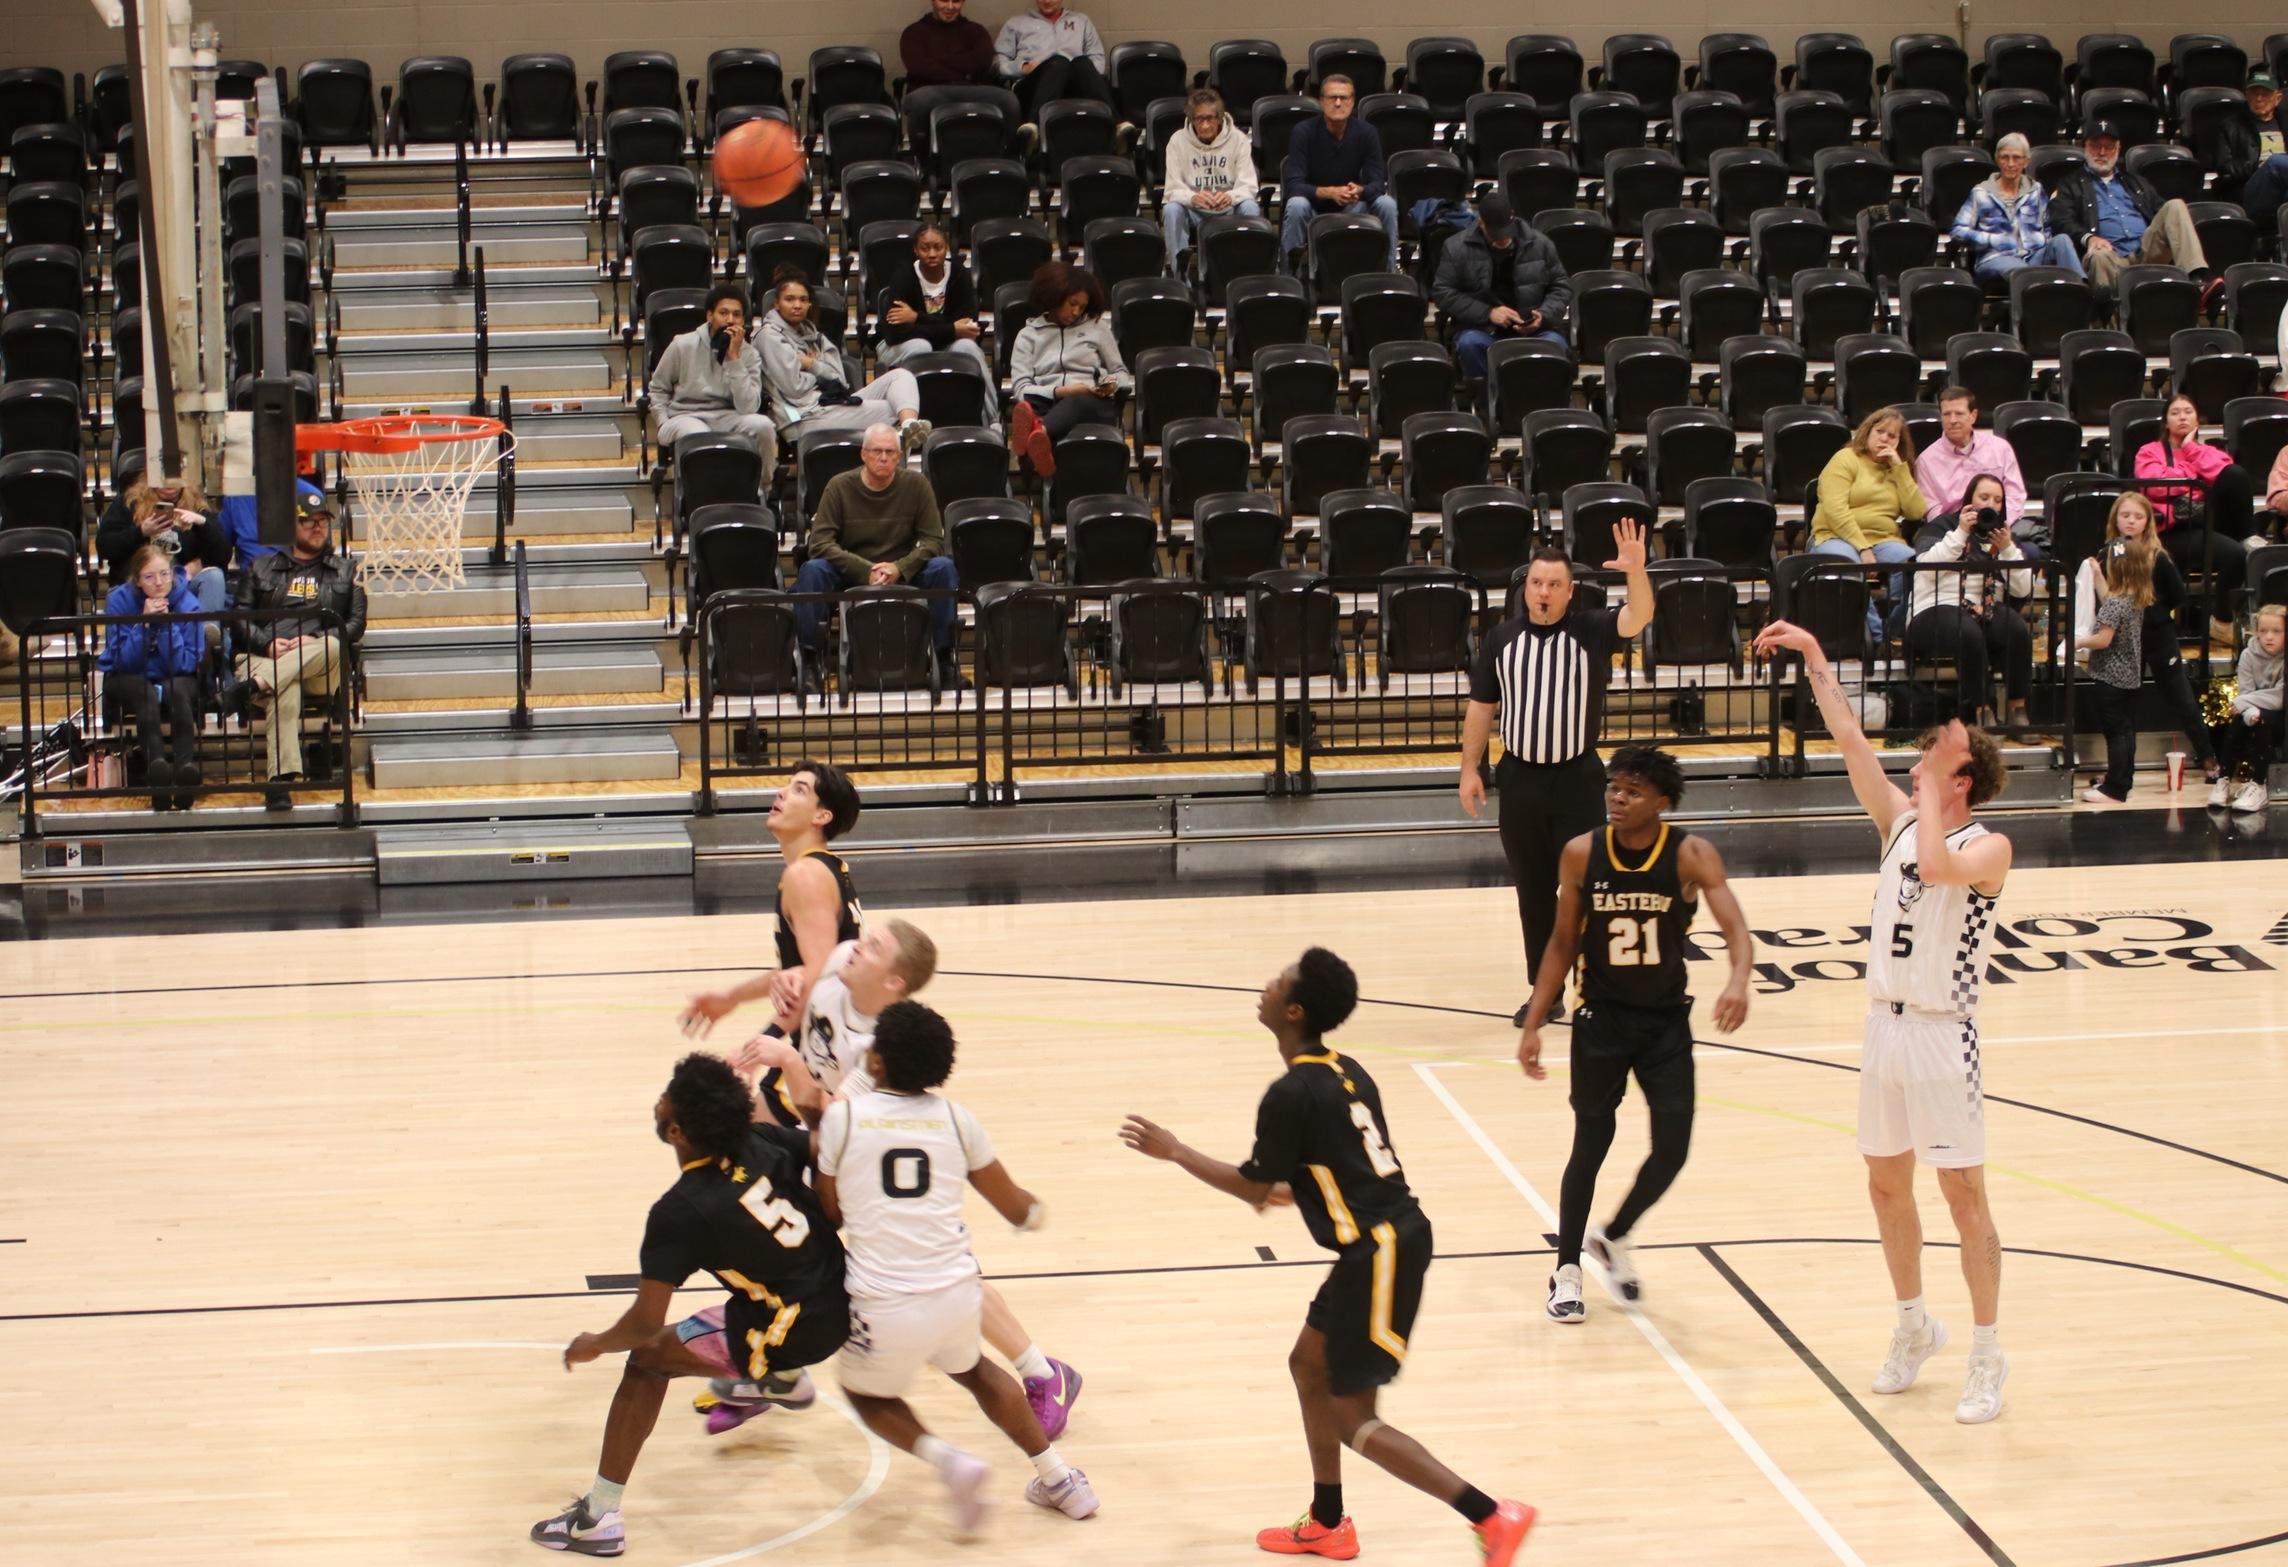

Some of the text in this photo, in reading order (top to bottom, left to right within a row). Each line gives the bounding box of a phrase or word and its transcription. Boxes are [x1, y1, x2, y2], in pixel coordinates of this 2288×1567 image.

[1063, 20, 1075, 31] M
[1195, 175, 1228, 187] UTAH
[2085, 907, 2188, 918] MEMBER
[1607, 916, 1662, 966] 21
[1891, 923, 1914, 958] 5
[1751, 959, 1868, 994] of
[1348, 1100, 1400, 1178] 2
[880, 1147, 930, 1199] 0
[738, 1174, 811, 1248] 5
